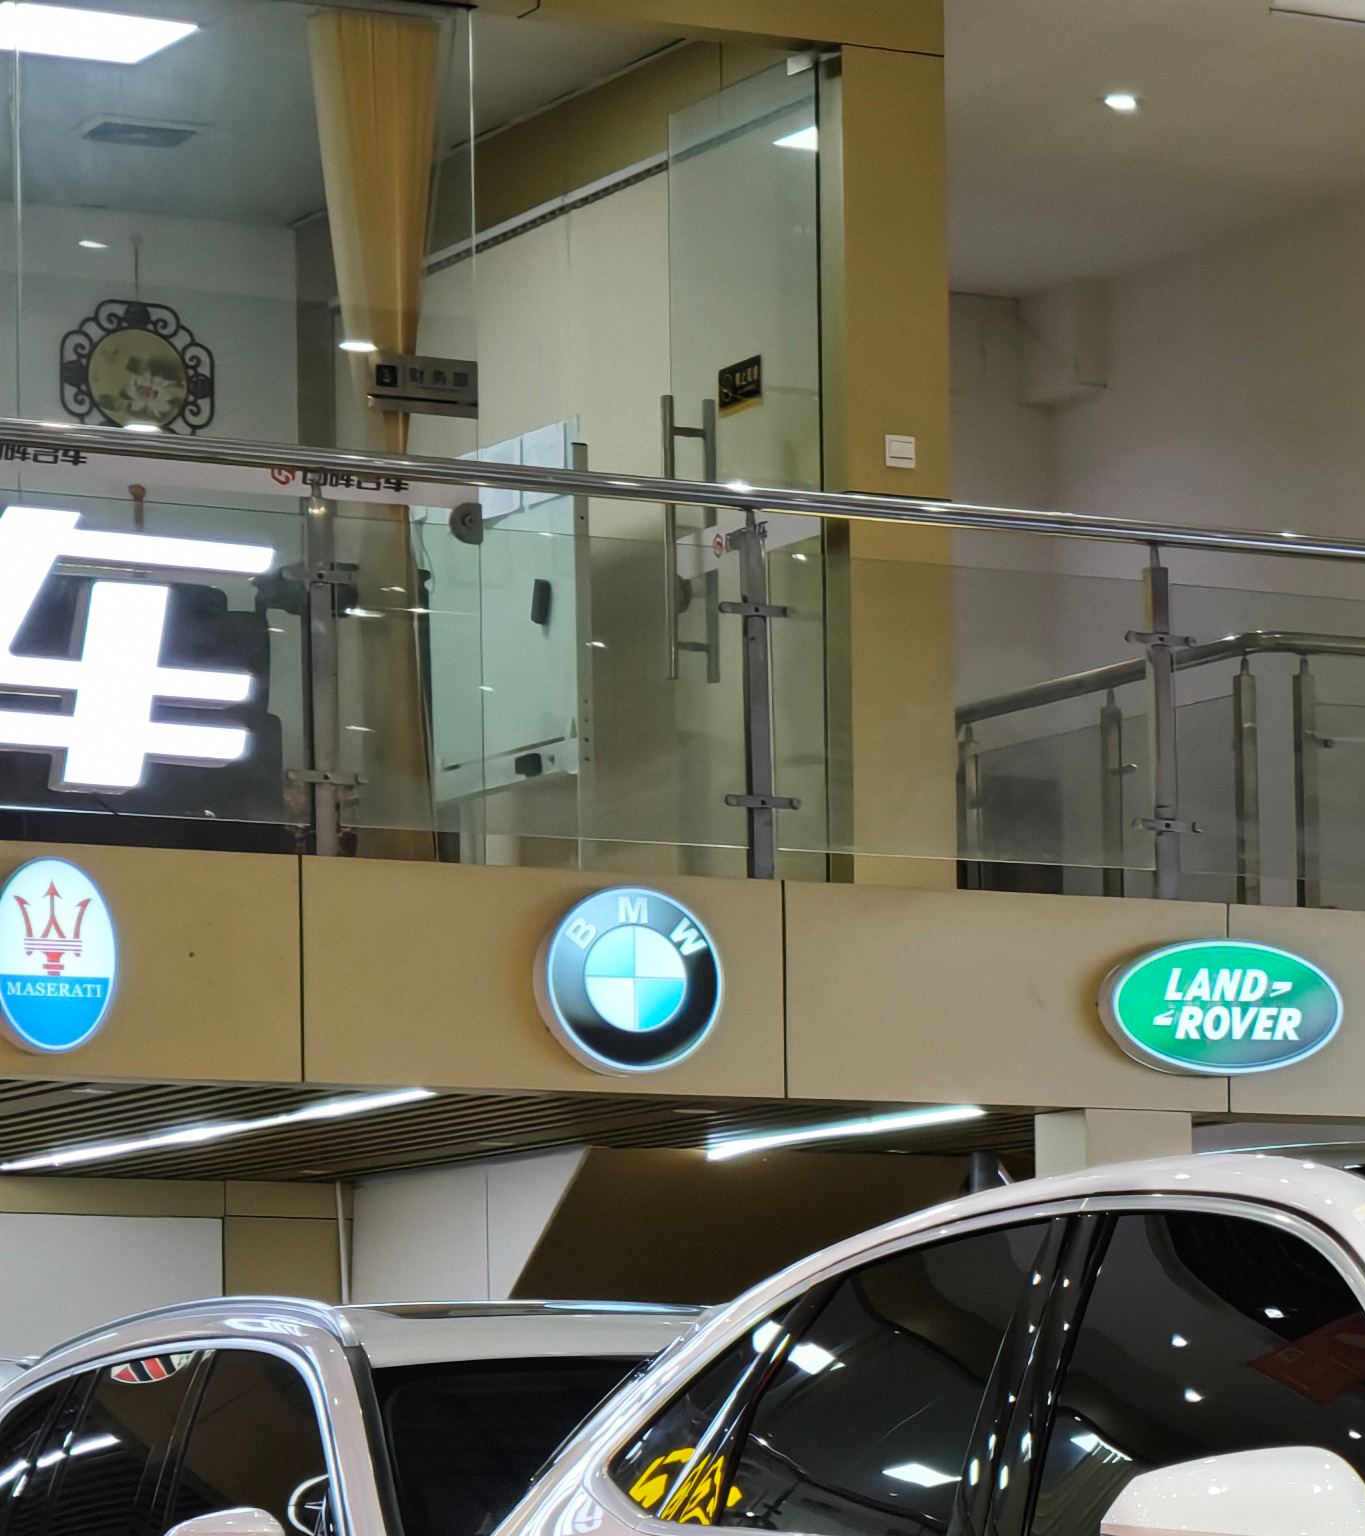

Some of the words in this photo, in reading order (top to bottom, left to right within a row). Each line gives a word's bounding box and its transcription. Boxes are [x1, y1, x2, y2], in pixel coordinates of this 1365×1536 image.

[563, 896, 710, 957] BMW
[6, 980, 103, 1000] MASERATI
[1164, 968, 1268, 1001] LAND
[1174, 1006, 1302, 1040] ROVER
